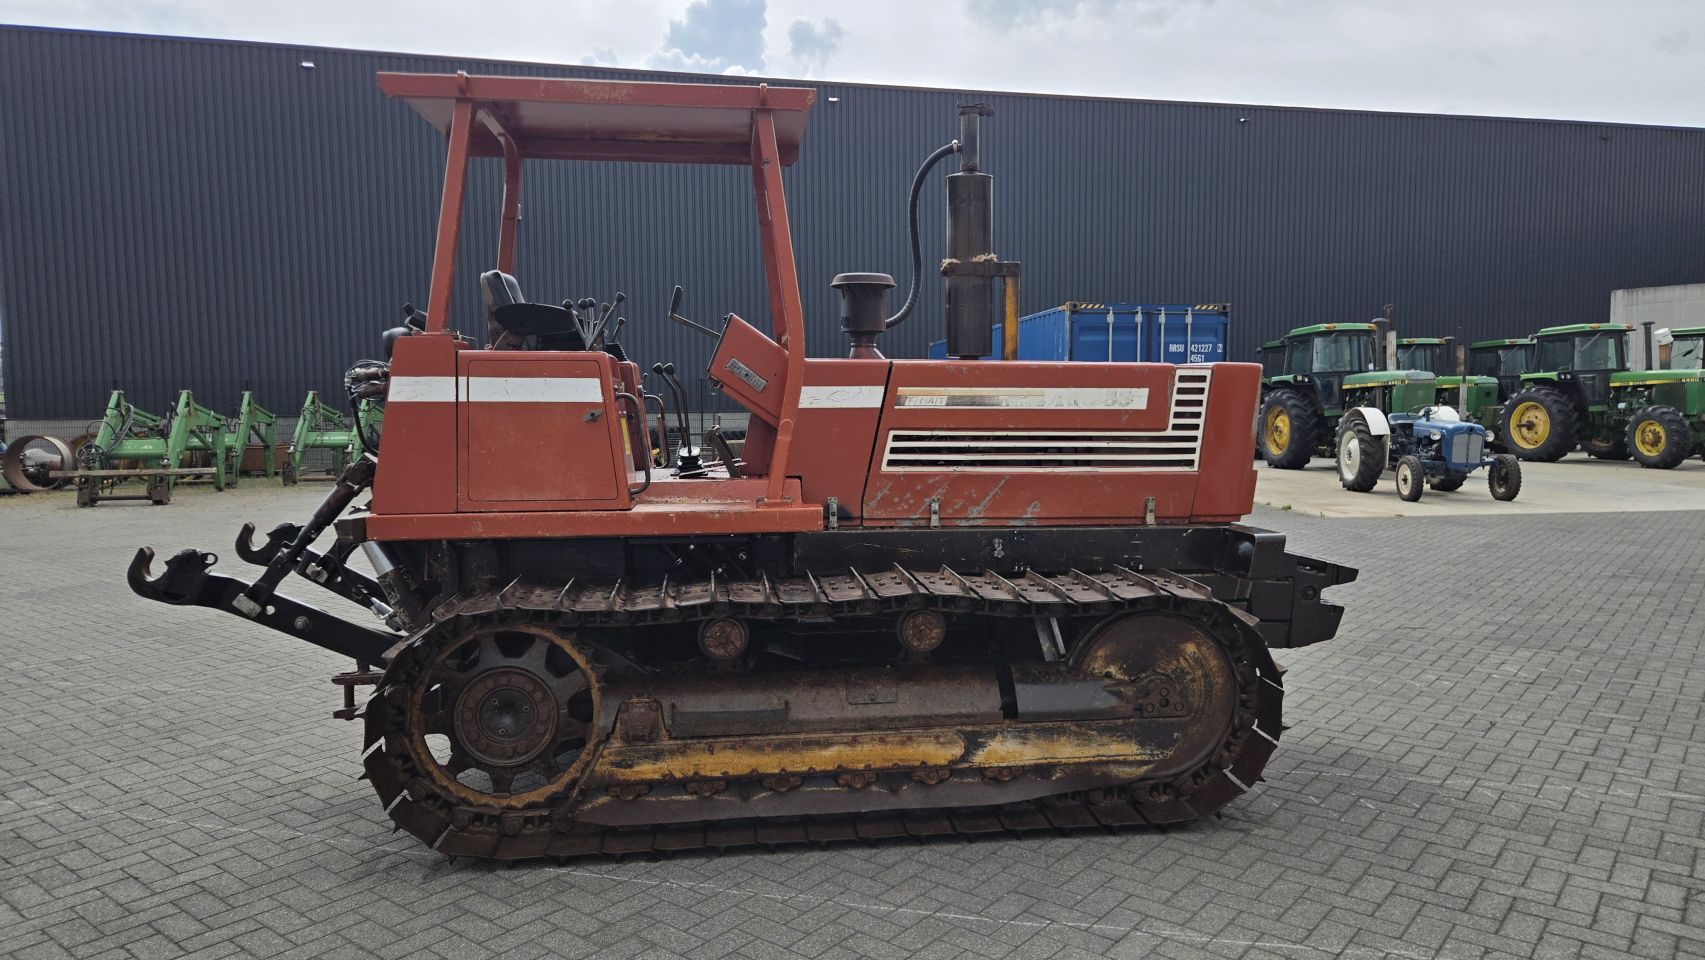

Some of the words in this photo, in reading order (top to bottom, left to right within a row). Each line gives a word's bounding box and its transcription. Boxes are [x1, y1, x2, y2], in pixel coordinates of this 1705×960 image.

[1191, 344, 1212, 352] 421227
[1217, 344, 1223, 352] 2
[906, 396, 946, 406] FIAT
